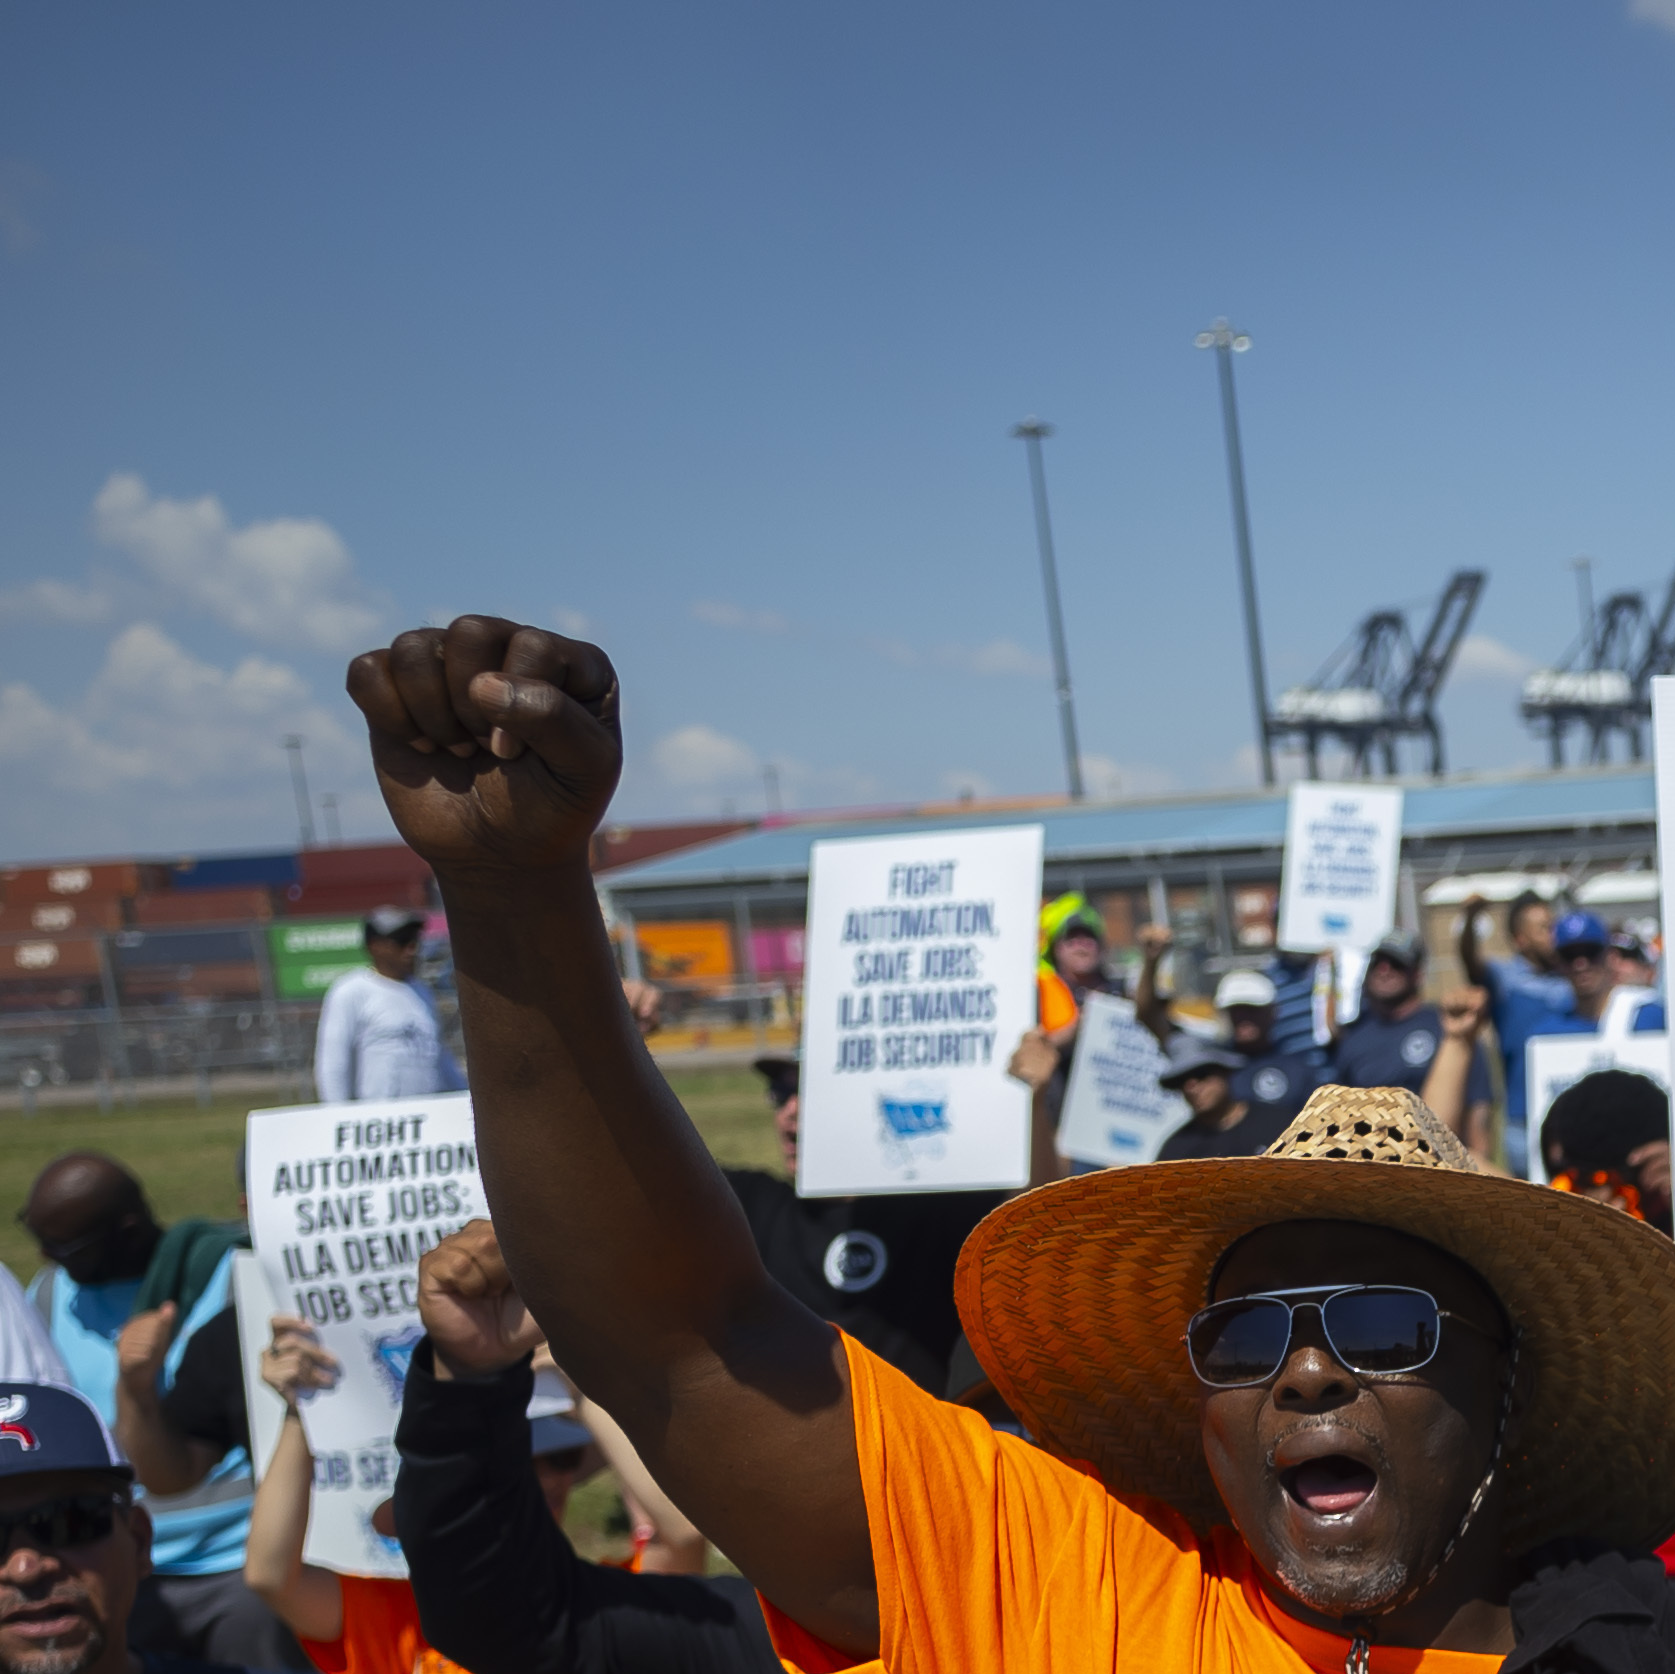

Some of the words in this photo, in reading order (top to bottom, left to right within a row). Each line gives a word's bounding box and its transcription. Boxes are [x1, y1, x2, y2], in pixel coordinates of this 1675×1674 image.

[889, 858, 956, 898] FIGHT
[853, 947, 914, 986] SAVE
[836, 993, 875, 1031] ILA
[878, 985, 999, 1028] DEMANDS
[835, 1035, 878, 1074] JOB
[880, 1028, 998, 1073] SECURITY
[334, 1114, 427, 1153] FIGHT
[294, 1194, 379, 1237] SAVE
[385, 1179, 473, 1227] JOBS:
[281, 1240, 338, 1285] ILA
[341, 1225, 463, 1279] DEMA
